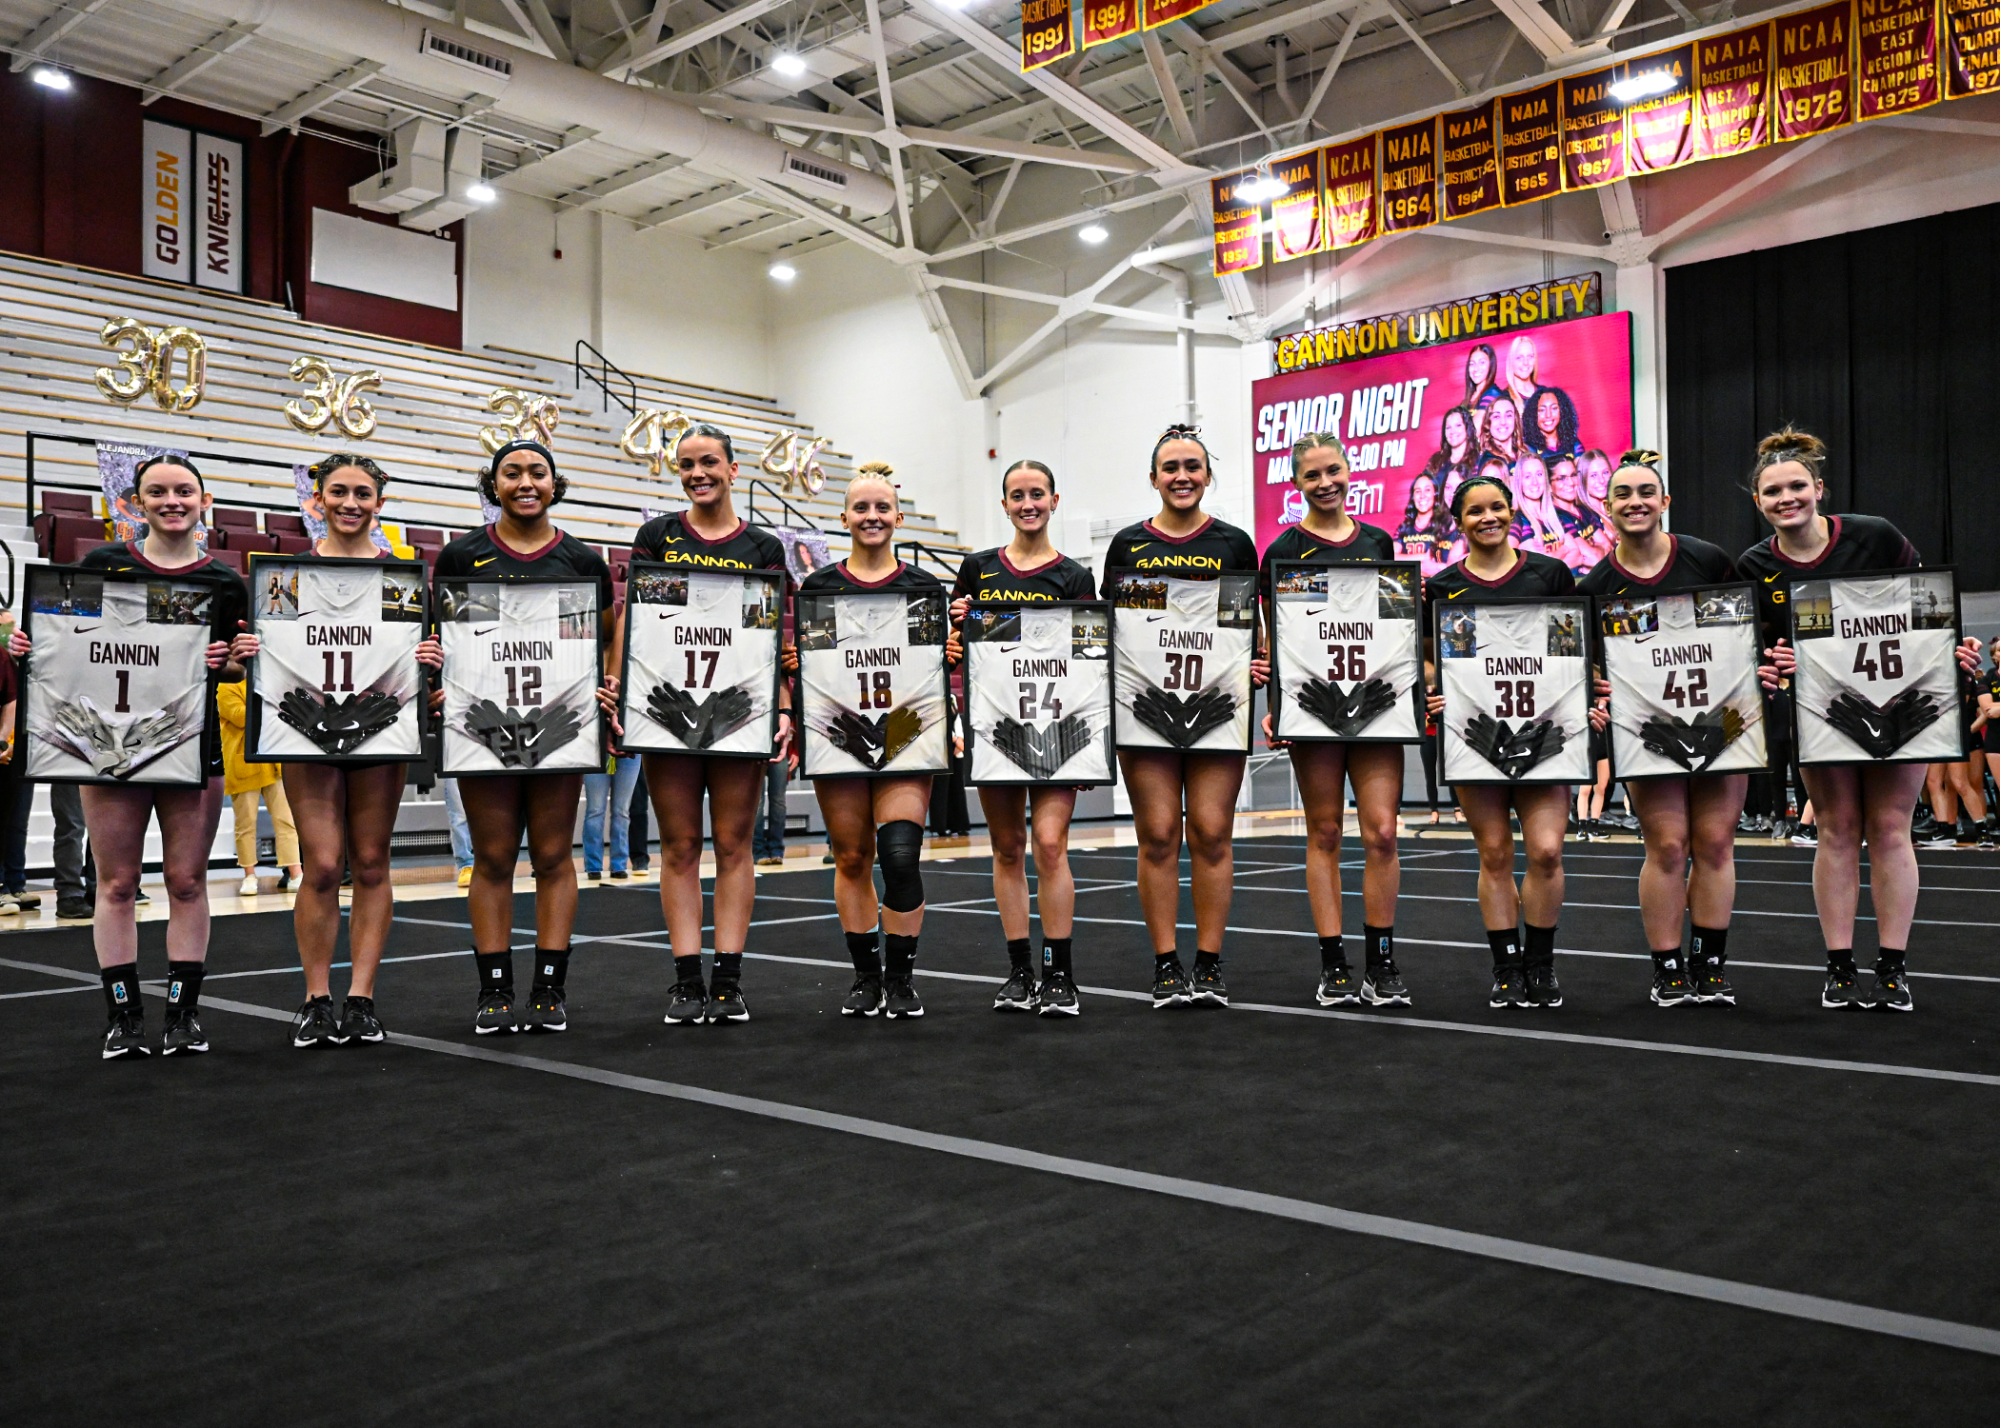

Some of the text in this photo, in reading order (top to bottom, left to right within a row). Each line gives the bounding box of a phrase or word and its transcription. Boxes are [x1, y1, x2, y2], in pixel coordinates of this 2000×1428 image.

[1089, 1, 1125, 31] 1994
[1861, 6, 1933, 38] BASKETBALL
[1784, 16, 1843, 55] NCAA
[1881, 29, 1914, 52] EAST
[1705, 36, 1760, 65] NAIA
[1868, 46, 1929, 75] REGIONAL
[1702, 58, 1765, 87] BASKETBALL
[1779, 53, 1847, 91] BASKETBALL
[1863, 63, 1934, 93] CHAMPIONS
[1747, 81, 1759, 96] 18
[1876, 85, 1920, 111] 1975
[1511, 99, 1548, 123] NAIA
[1565, 109, 1625, 131] BASKETBALL
[1702, 102, 1765, 129] CHAMPIONS
[1785, 89, 1842, 124] 1972
[1449, 115, 1487, 139] NAIA
[1503, 122, 1557, 147] BASKETBALL
[1388, 131, 1431, 163] NAIA
[1506, 146, 1558, 171] DISTRICT 18
[1566, 134, 1607, 156] DISTRICT
[1279, 164, 1311, 186] NAIA
[1330, 148, 1371, 180] NCAA
[1383, 162, 1434, 192] BASKETBALL
[1445, 166, 1483, 186] DISTRICT
[1578, 158, 1611, 177] 1967
[1328, 181, 1373, 208] BASKETBALL
[1457, 186, 1484, 206] 1964
[1515, 172, 1548, 192] 1965
[156, 150, 179, 265] GOLDEN
[207, 152, 230, 275] KNIGHTS
[1387, 193, 1431, 220] 1964
[1334, 208, 1370, 237] 1962
[1277, 280, 1590, 369] GANNON UNIVERSITY
[94, 317, 207, 414] 30
[284, 355, 383, 441] 36
[1256, 377, 1429, 453] SENIOR NIGHT
[97, 443, 147, 457] ALEJANDRA
[760, 429, 827, 496] 46
[1347, 442, 1380, 473] 6:00
[1381, 438, 1407, 468] PM
[664, 550, 753, 570] GANNON
[1136, 555, 1222, 570] GANNON
[306, 625, 372, 646] GANNON
[674, 626, 732, 646] GANNON
[1158, 629, 1213, 650] GANNON
[1319, 622, 1373, 641] GANNON
[1841, 613, 1908, 639] GANNON
[90, 641, 160, 667] GANNON
[491, 641, 553, 662] GANNON
[845, 647, 901, 668] GANNON
[1327, 645, 1366, 681] 36
[1652, 644, 1712, 667] GANNON
[1853, 640, 1903, 681] 46
[322, 651, 354, 692] 11
[684, 650, 720, 688] 17
[1012, 659, 1068, 678] GANNON
[1163, 653, 1203, 691] 30
[1485, 657, 1543, 676] GANNON
[115, 670, 131, 713] 1
[504, 666, 542, 706] 12
[857, 671, 893, 710] 18
[1018, 682, 1063, 719] 24
[1494, 680, 1535, 718] 38
[1662, 668, 1709, 708] 42
